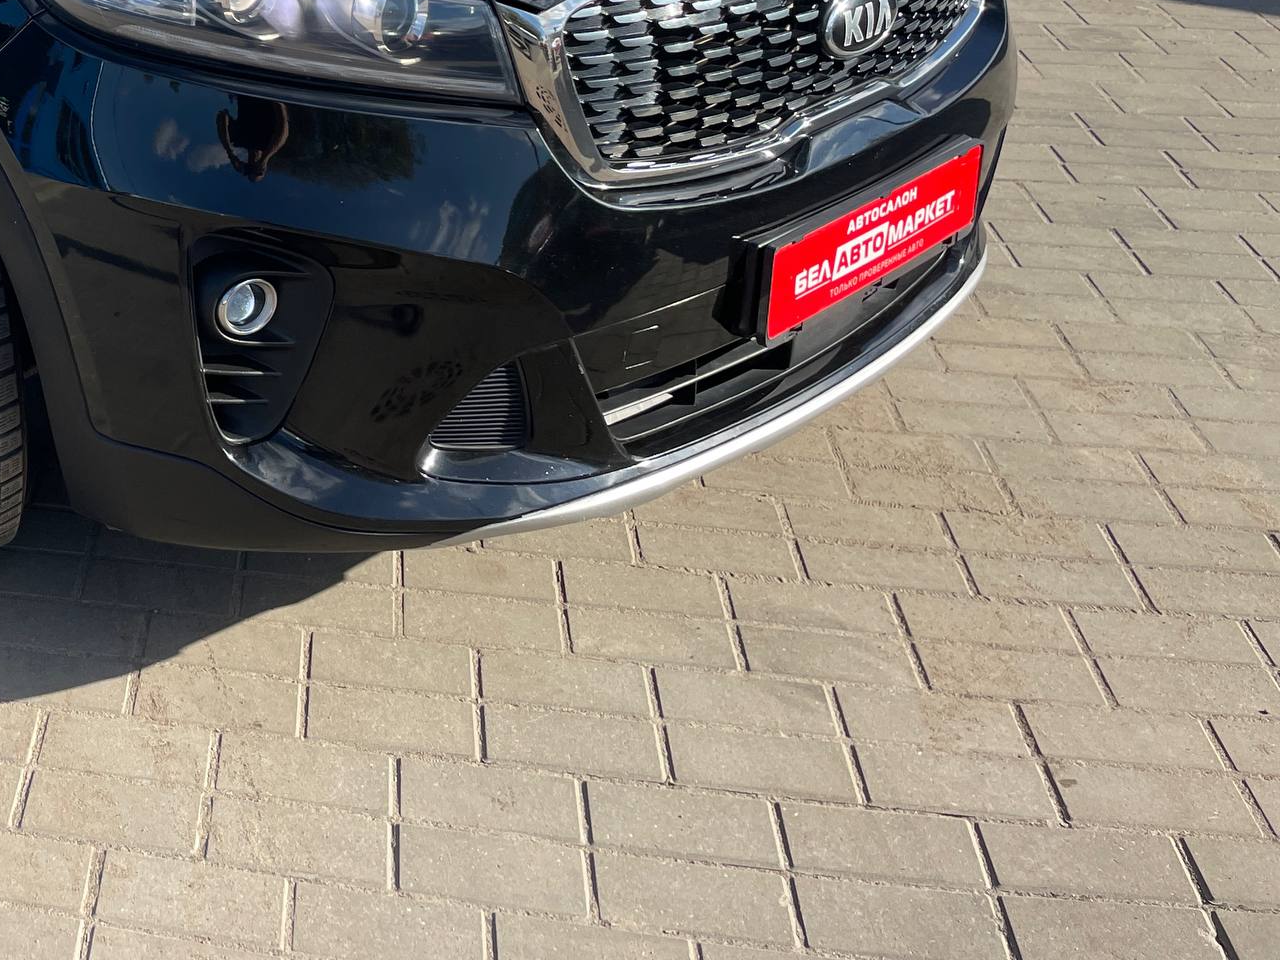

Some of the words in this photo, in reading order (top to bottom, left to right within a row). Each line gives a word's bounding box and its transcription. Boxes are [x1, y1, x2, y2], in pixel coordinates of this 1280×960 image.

[847, 187, 918, 235] АВТОСАЛОН
[830, 277, 858, 298] ТОЛЬКО
[859, 248, 907, 281] ПРОВЕРЕННЫЕ
[907, 238, 924, 255] АВТО
